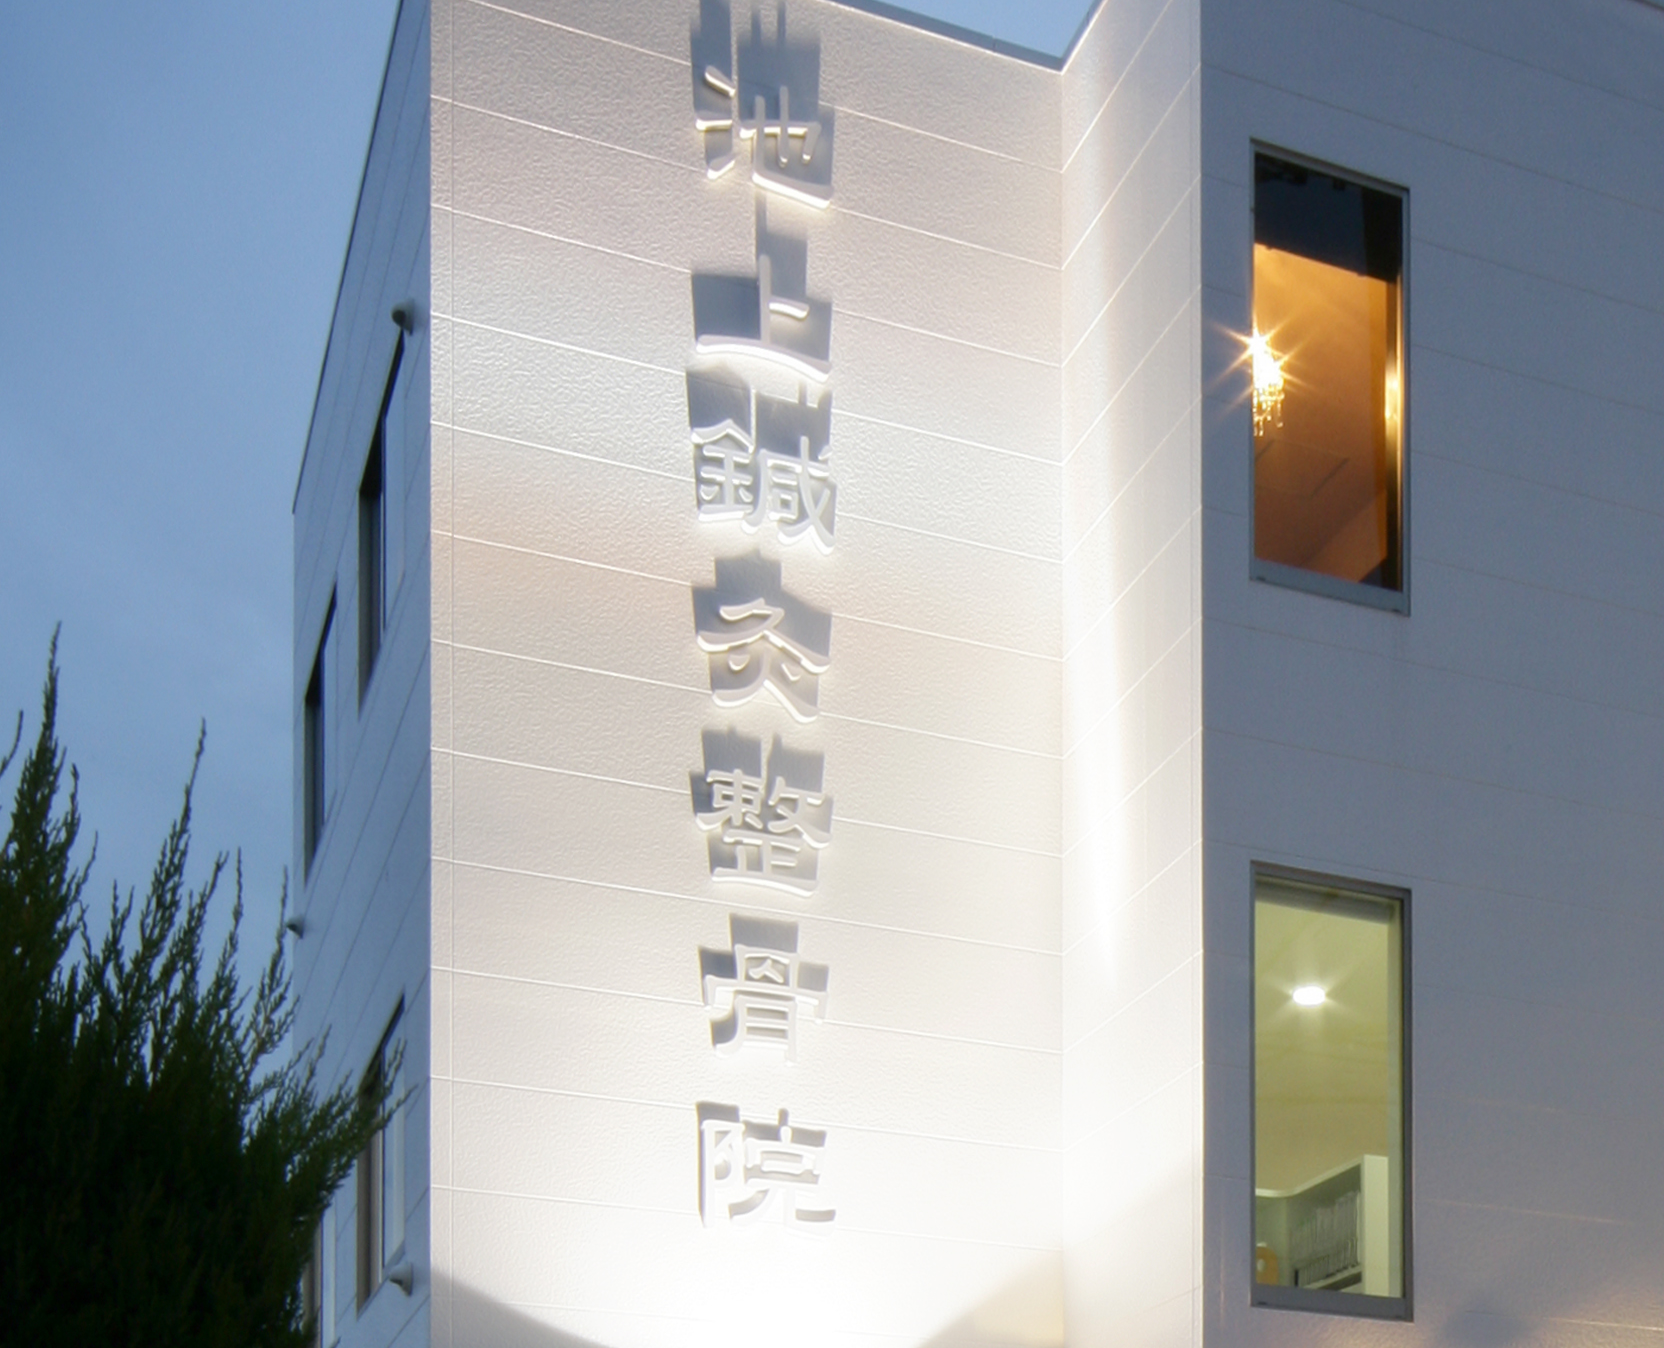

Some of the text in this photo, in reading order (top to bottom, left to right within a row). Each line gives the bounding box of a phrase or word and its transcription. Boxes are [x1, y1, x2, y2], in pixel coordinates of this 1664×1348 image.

[691, 64, 838, 1234] 池上鍼灸整骨院
